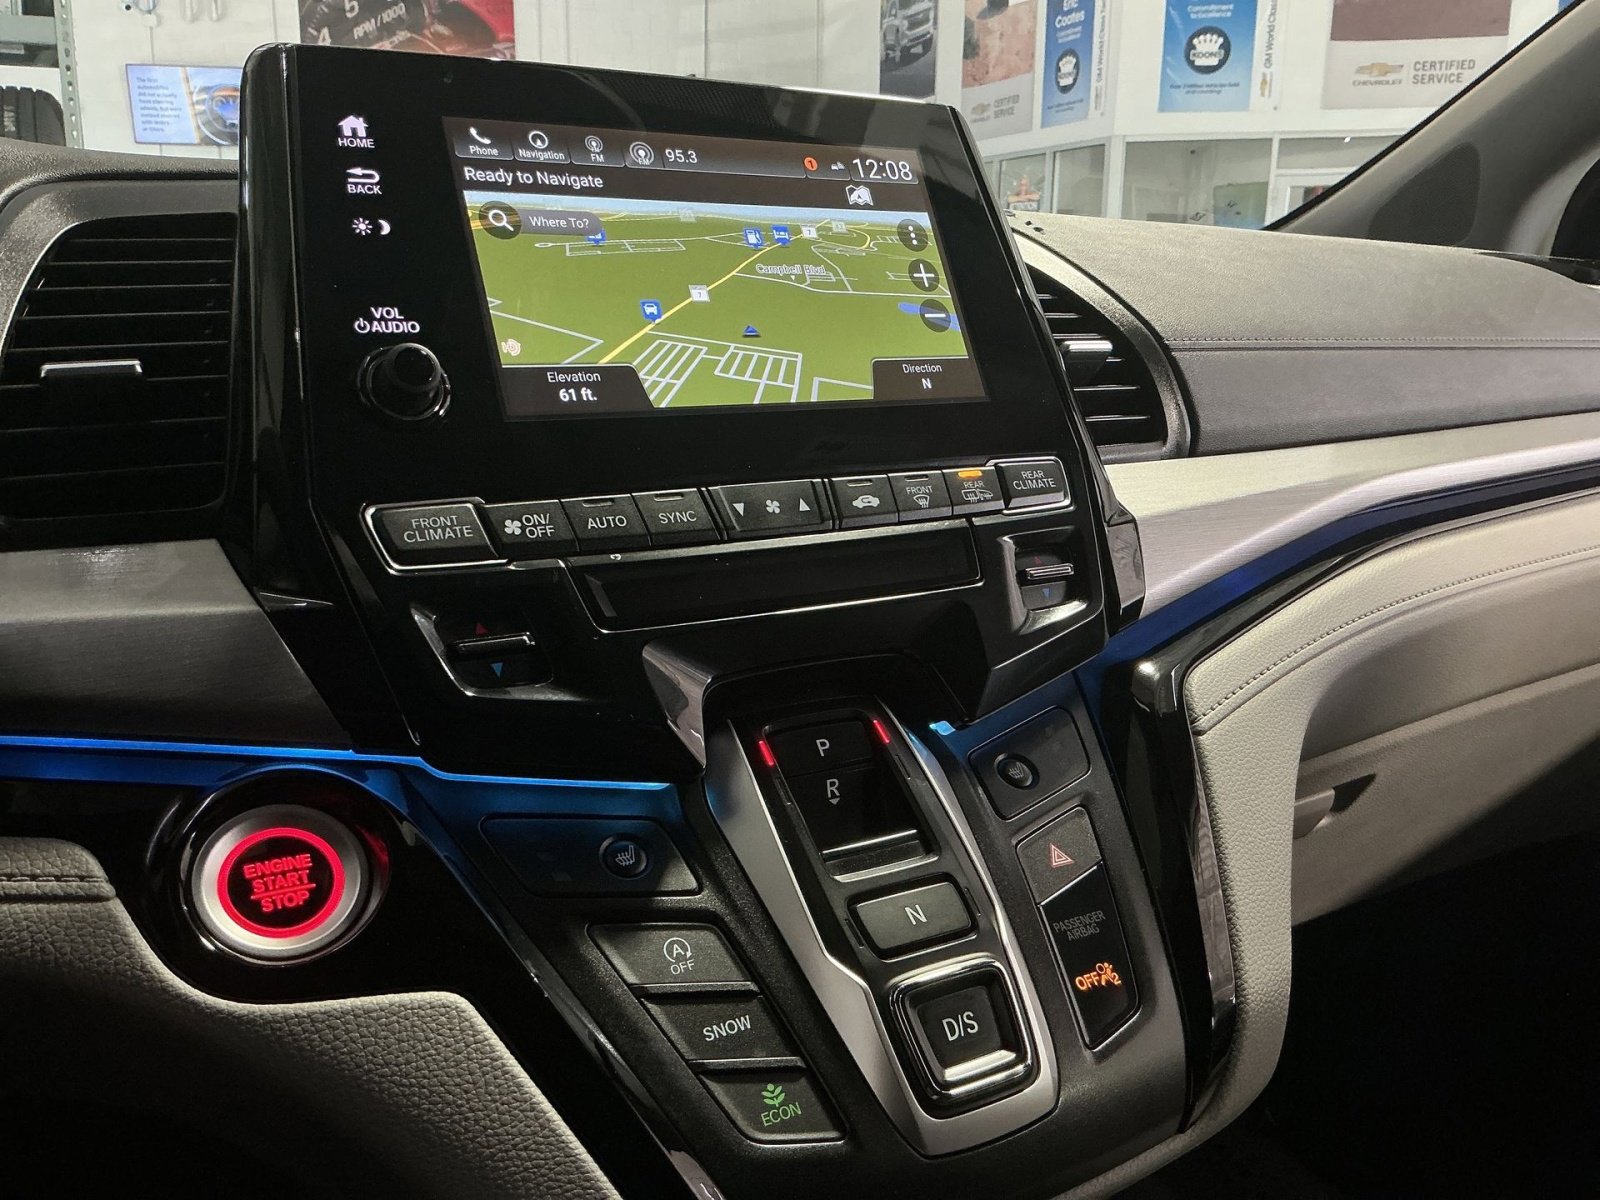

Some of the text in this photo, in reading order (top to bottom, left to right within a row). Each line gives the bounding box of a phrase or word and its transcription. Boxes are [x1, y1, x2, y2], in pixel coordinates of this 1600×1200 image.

[1055, 10, 1086, 28] Coates
[353, 18, 376, 39] RPM
[1264, 24, 1275, 51] World
[1413, 59, 1476, 72] CERTIFIED
[1411, 72, 1464, 85] SERVICE
[338, 137, 375, 149] HOME
[469, 145, 499, 156] Phone
[518, 149, 565, 161] Navigation
[590, 153, 605, 163] FM
[665, 149, 698, 164] 95.3
[852, 158, 913, 181] 12:08
[464, 167, 604, 190] Ready to Navigate
[347, 184, 382, 195] BACK
[529, 216, 589, 229] Where To?
[756, 263, 826, 276] Campbell Blvd
[371, 307, 404, 320] VOL
[372, 320, 421, 333] AUDIO
[902, 363, 942, 374] Direction
[547, 372, 601, 383] Elevation
[921, 378, 932, 389] N
[559, 387, 598, 402] 61 ft.
[1021, 470, 1045, 480] REAR
[906, 484, 934, 495] FRONT
[963, 480, 985, 490] REAR
[1013, 477, 1056, 490] CLIMATE
[411, 515, 458, 530] FRONT
[522, 513, 550, 527] ON/
[587, 515, 627, 530] AUTO
[658, 510, 697, 525] SYNC
[403, 525, 473, 544] CLIMATE
[526, 525, 555, 539] OFF
[815, 739, 830, 757] P
[826, 778, 839, 797] R
[243, 853, 313, 879] ENGINE
[252, 870, 311, 893] START
[261, 890, 310, 912] STOP
[904, 904, 927, 925] N
[1053, 910, 1106, 933] PASSENGER
[1067, 923, 1100, 941] AIRBAG
[670, 959, 695, 975] OFF
[1075, 971, 1099, 990] OFF
[703, 1015, 751, 1042] SNOW
[942, 1011, 979, 1042] D/S
[761, 1102, 802, 1126] ECON
